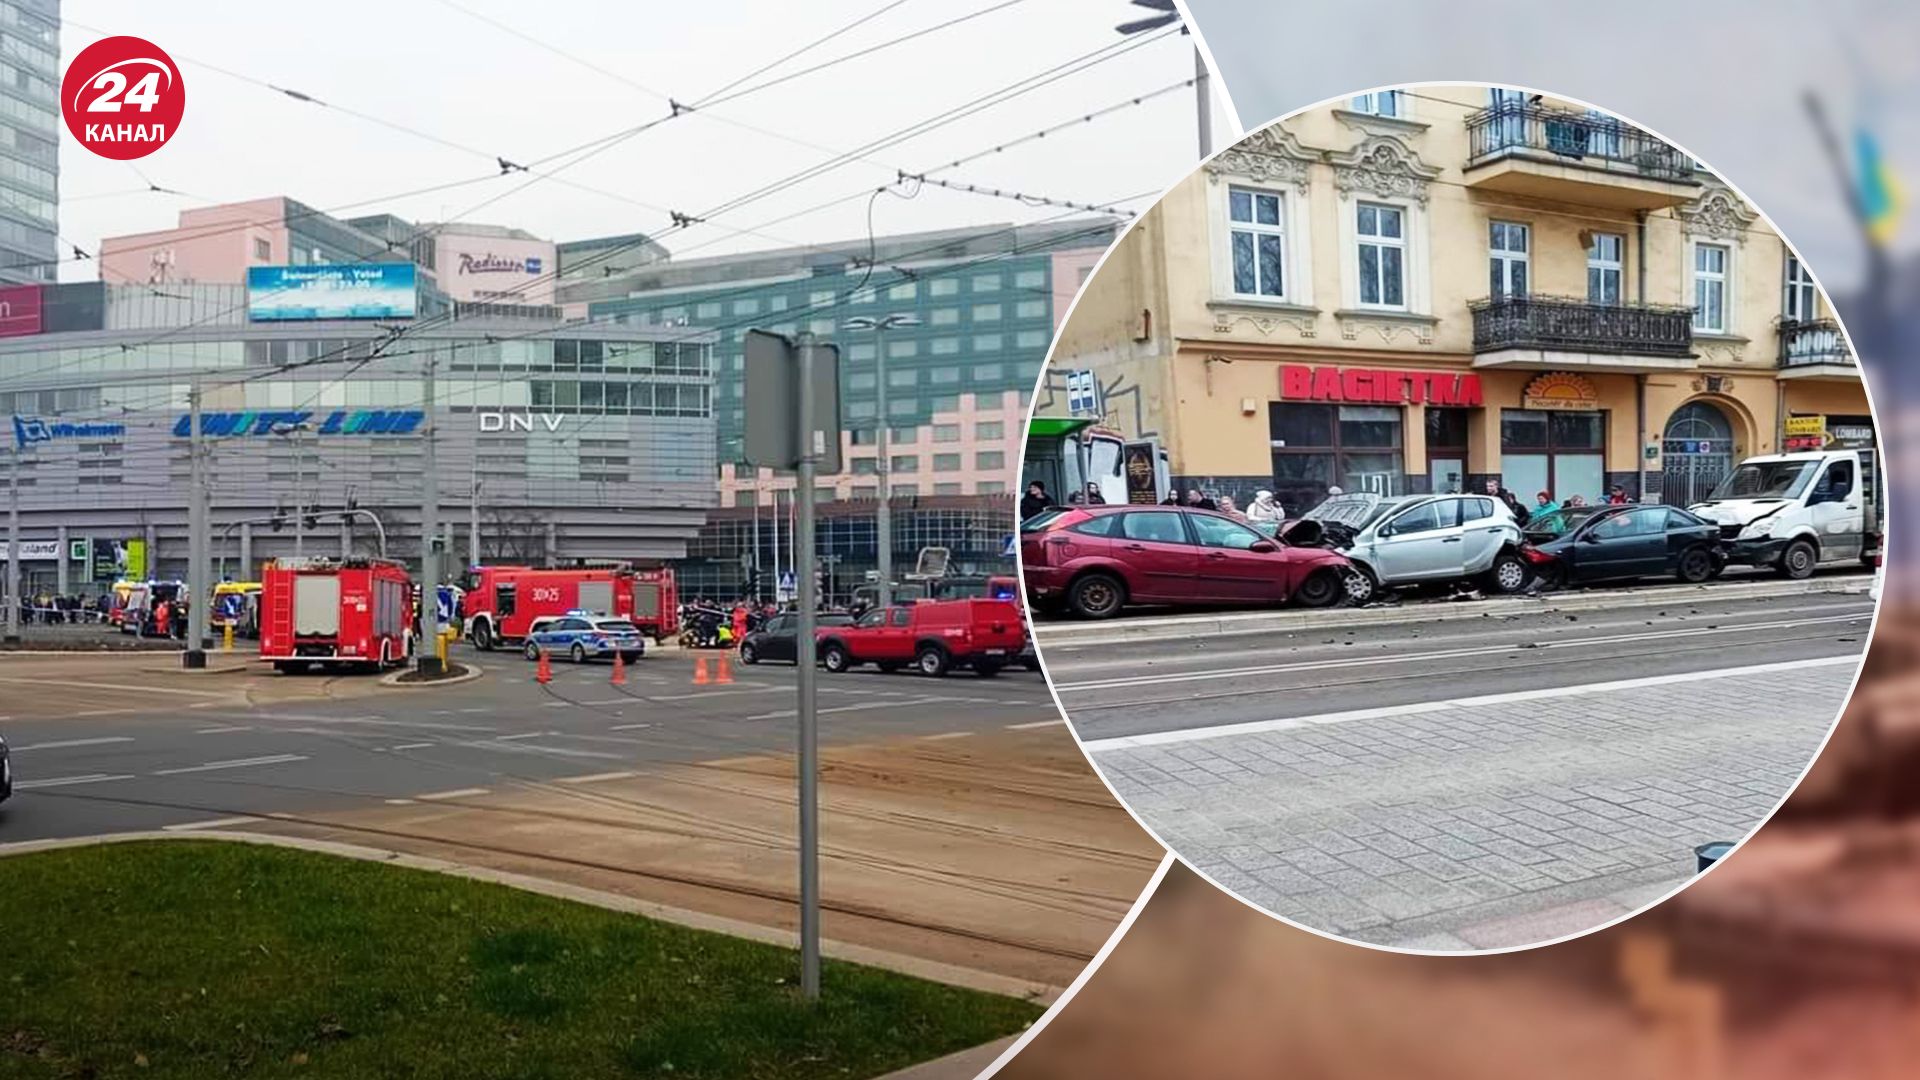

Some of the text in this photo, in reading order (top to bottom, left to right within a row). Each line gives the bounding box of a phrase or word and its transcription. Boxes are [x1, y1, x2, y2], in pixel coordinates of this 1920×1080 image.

[1279, 364, 1483, 406] BAGIETKA
[480, 412, 564, 432] DNV
[1835, 428, 1872, 440] LOMBARD
